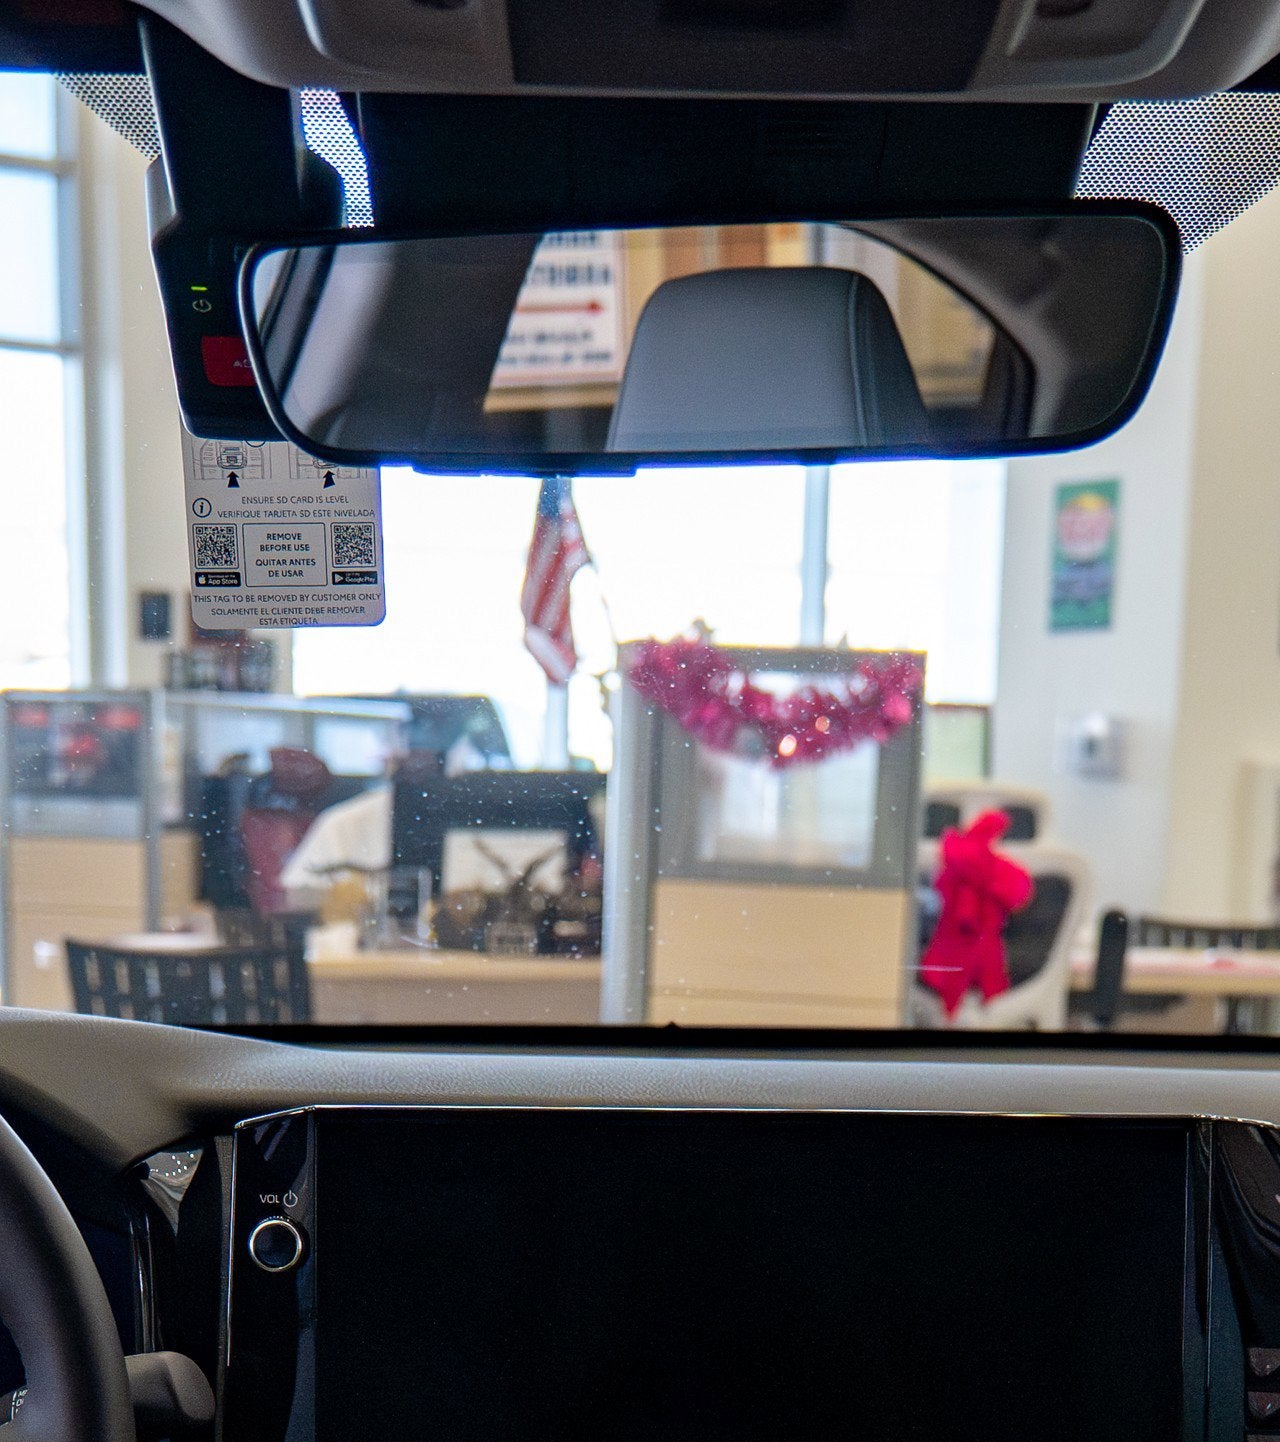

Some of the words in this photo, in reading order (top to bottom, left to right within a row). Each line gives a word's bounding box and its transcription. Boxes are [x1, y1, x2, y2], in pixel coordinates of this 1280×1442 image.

[241, 496, 276, 504] ENSURE
[276, 496, 288, 504] SD
[290, 496, 314, 504] CARD
[316, 495, 324, 504] IS
[325, 495, 350, 504] LEVEL
[217, 509, 261, 519] VERIFIQUE
[264, 510, 298, 518] TARJETA
[300, 509, 311, 518] SD
[312, 509, 332, 518] ESTE
[334, 508, 376, 518] NIVELADA
[266, 532, 302, 541] REMOVE
[260, 544, 292, 552] BEFORE
[294, 544, 310, 552] USE
[255, 558, 288, 567] QUITAR
[288, 558, 316, 566] ANTES
[268, 570, 280, 578] DE
[281, 570, 304, 578] USAR
[194, 595, 212, 603] THIS
[214, 595, 230, 603] TAG
[257, 594, 298, 602] REMOVED
[300, 594, 311, 602] BY
[311, 594, 356, 602] CUSTOMER
[358, 593, 381, 601] ONLY
[210, 608, 258, 616] SOLAMENTE
[260, 608, 269, 616] EL
[271, 607, 303, 615] CLIENTE
[304, 606, 325, 614] DEBE
[326, 606, 366, 614] REMOVER
[259, 618, 278, 626] ESTA
[280, 617, 318, 625] ETIQUETA
[259, 1194, 280, 1204] VOL
